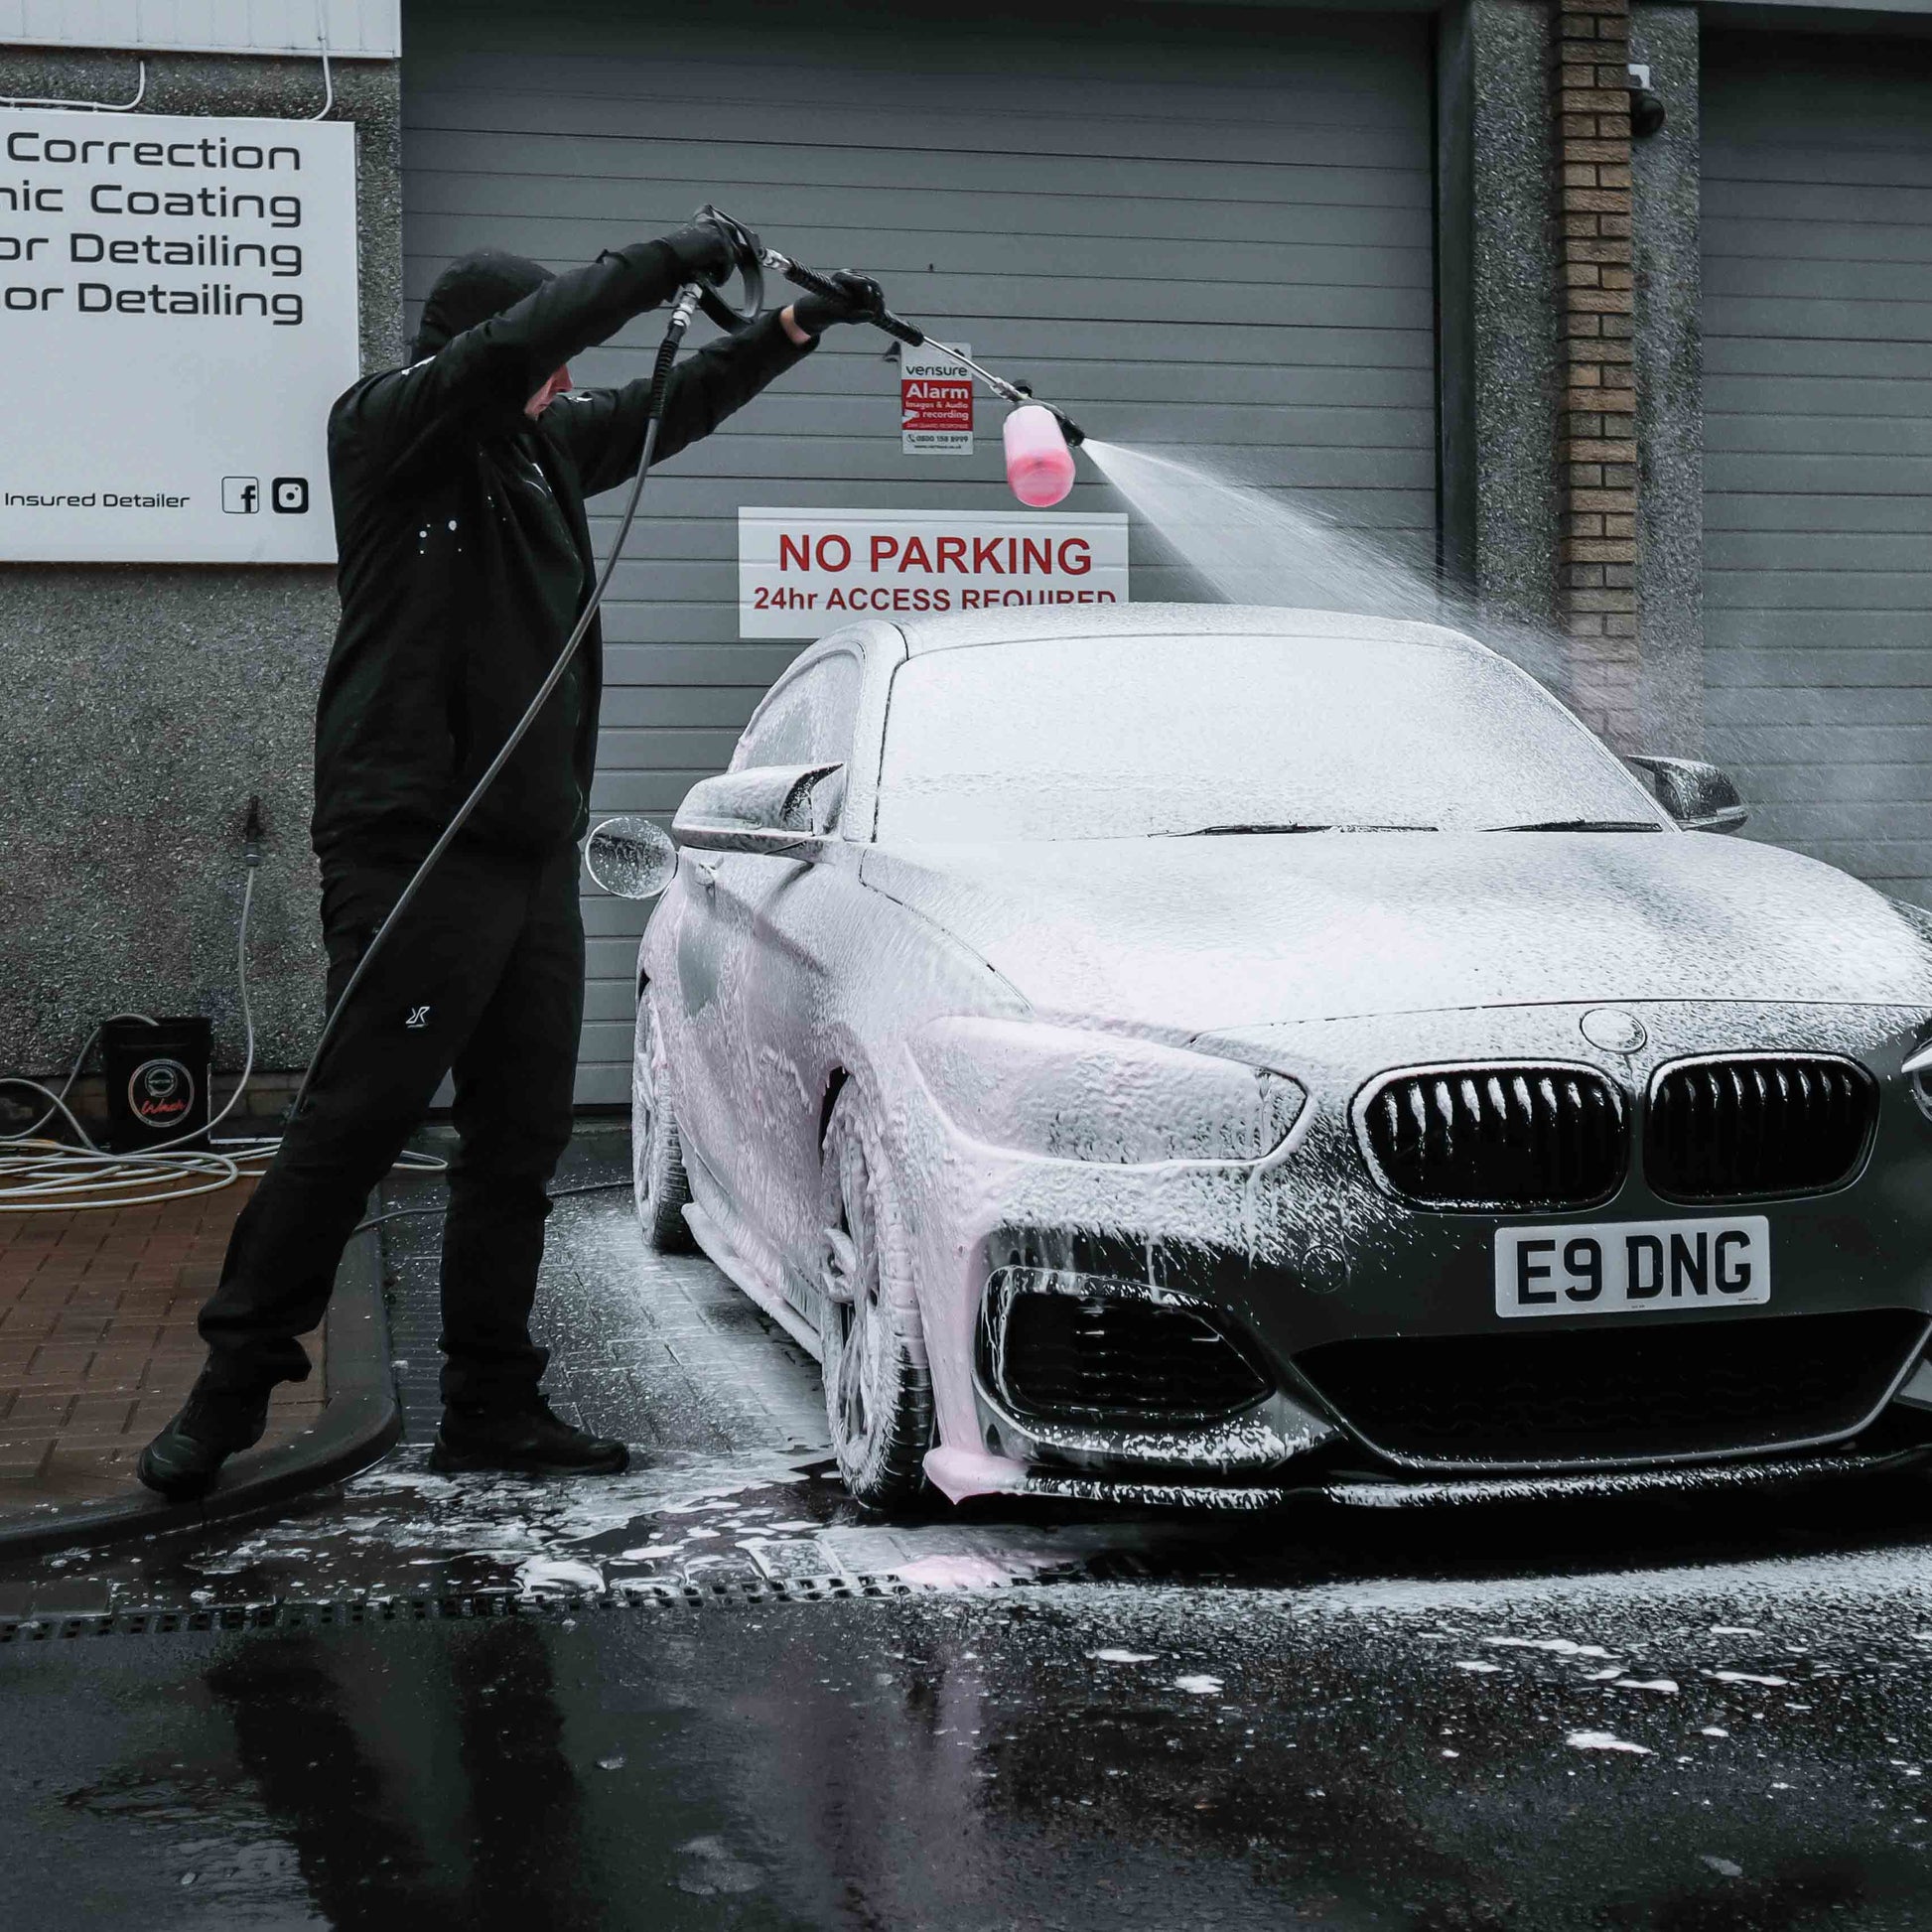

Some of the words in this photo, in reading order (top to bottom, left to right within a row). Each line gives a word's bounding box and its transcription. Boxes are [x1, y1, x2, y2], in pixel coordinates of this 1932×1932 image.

[7, 132, 300, 170] Correction
[90, 184, 302, 227] Coating
[70, 233, 302, 276] Detailing
[4, 287, 64, 311] or
[78, 283, 303, 326] Detailing
[905, 365, 968, 376] verisure
[905, 382, 969, 399] Alarm
[922, 410, 969, 421] recording
[5, 492, 95, 506] Insured
[103, 493, 190, 507] Detailer
[779, 534, 851, 572] NO
[870, 535, 1092, 575] PARKING
[754, 587, 818, 611] 24hr
[826, 589, 951, 612] ACCESS
[1517, 1237, 1602, 1305] E9
[1625, 1230, 1751, 1300] DNG
